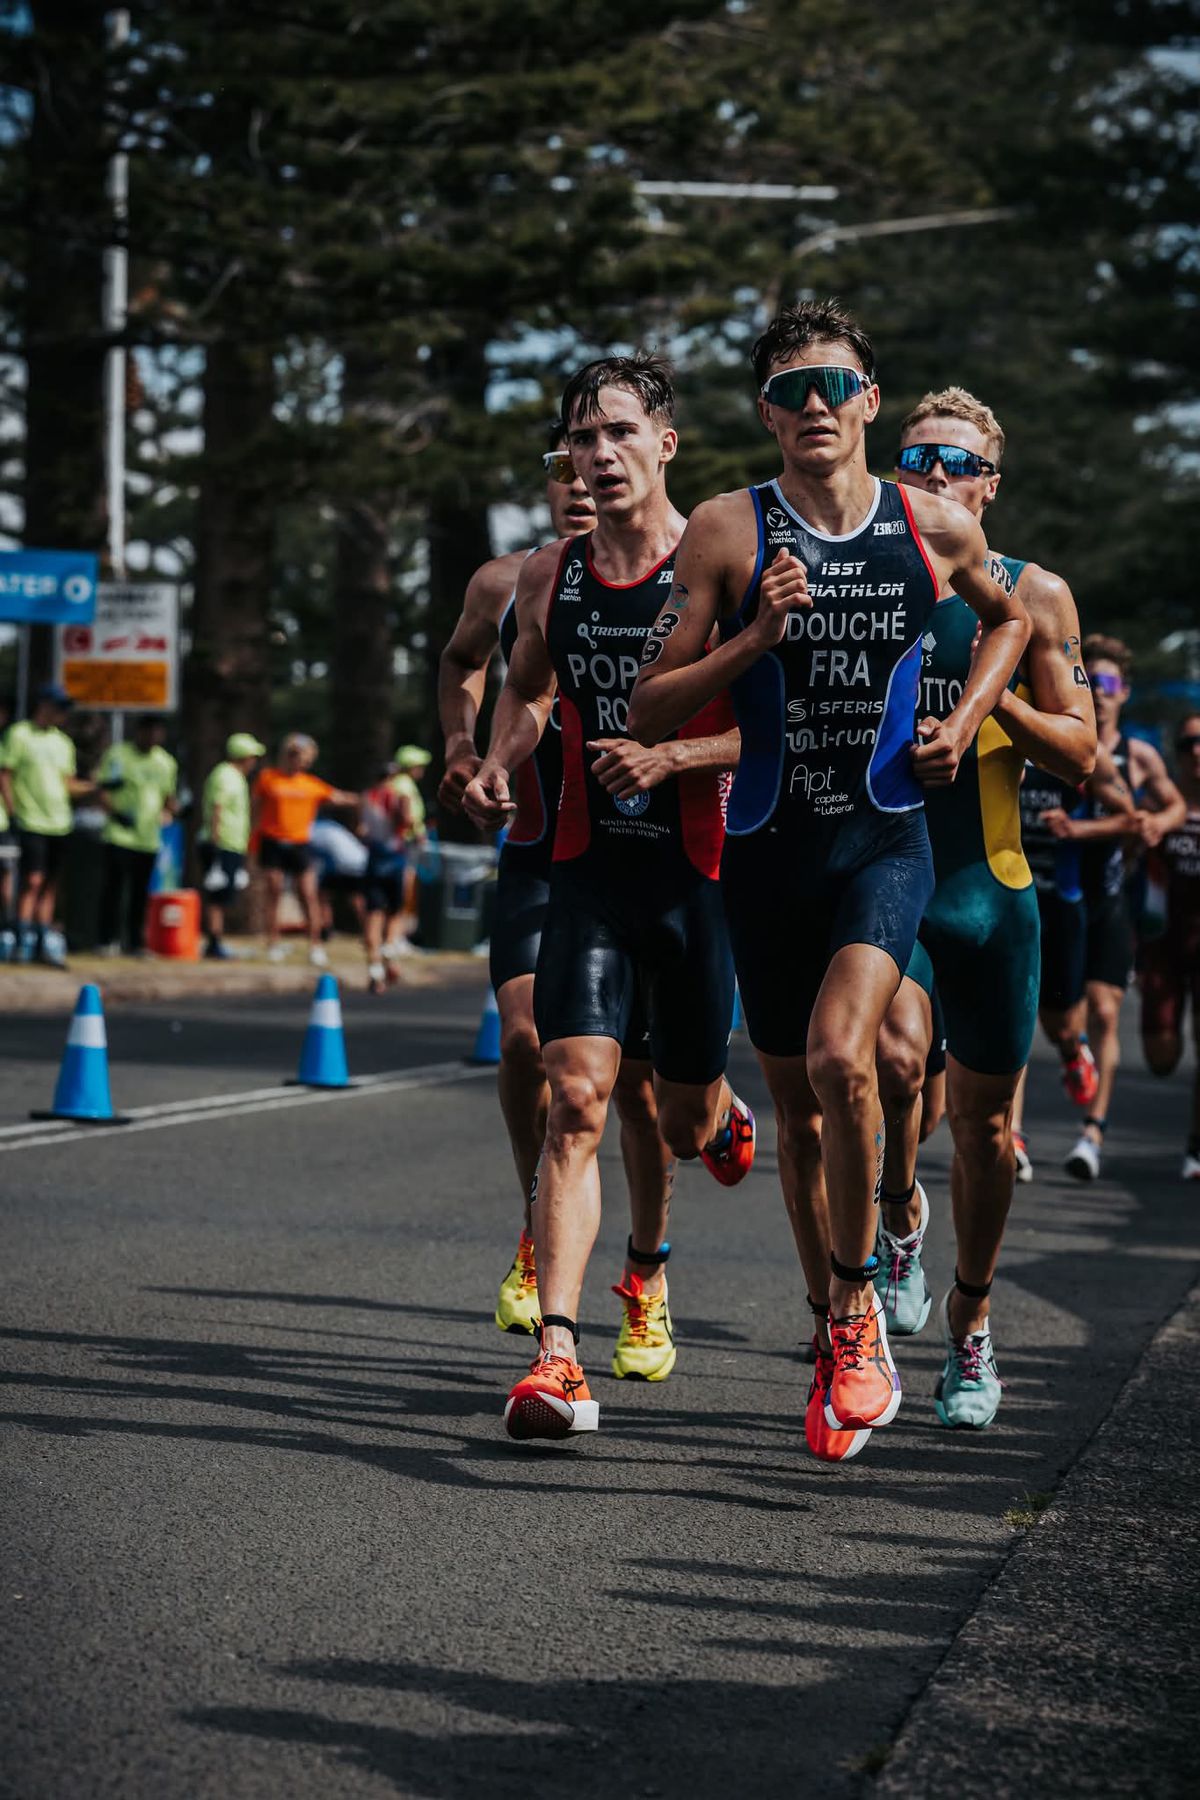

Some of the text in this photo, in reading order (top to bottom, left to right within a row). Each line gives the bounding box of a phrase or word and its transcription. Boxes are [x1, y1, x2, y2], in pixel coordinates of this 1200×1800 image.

[767, 536, 797, 546] Triathlon
[770, 529, 791, 537] World
[821, 561, 867, 576] ISSY
[786, 603, 906, 641] DOUCHÉ
[808, 649, 871, 687] FRA
[789, 764, 836, 800] Apt
